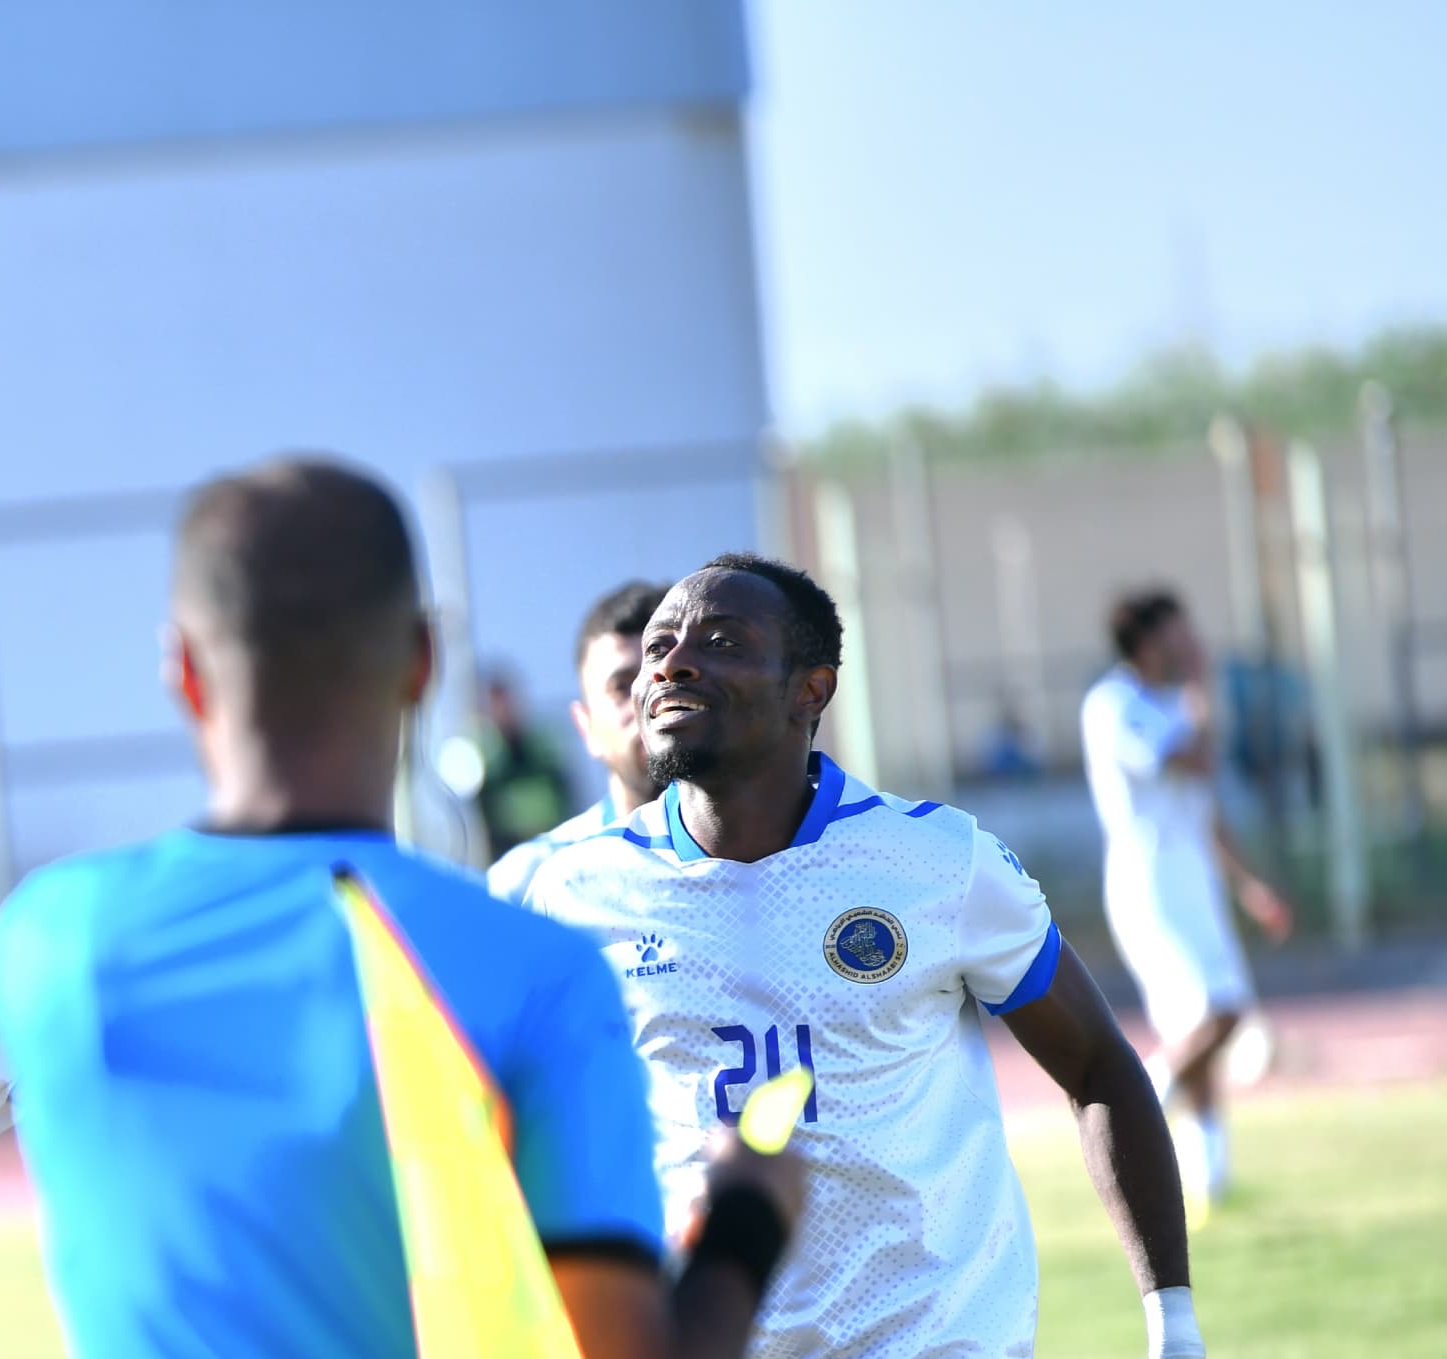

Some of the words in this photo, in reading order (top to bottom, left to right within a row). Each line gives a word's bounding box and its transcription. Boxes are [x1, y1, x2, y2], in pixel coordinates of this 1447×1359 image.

[626, 962, 677, 979] KELME
[829, 952, 859, 978] ALHASHID
[860, 960, 898, 980] ALSHAABI
[711, 1024, 818, 1127] 24
